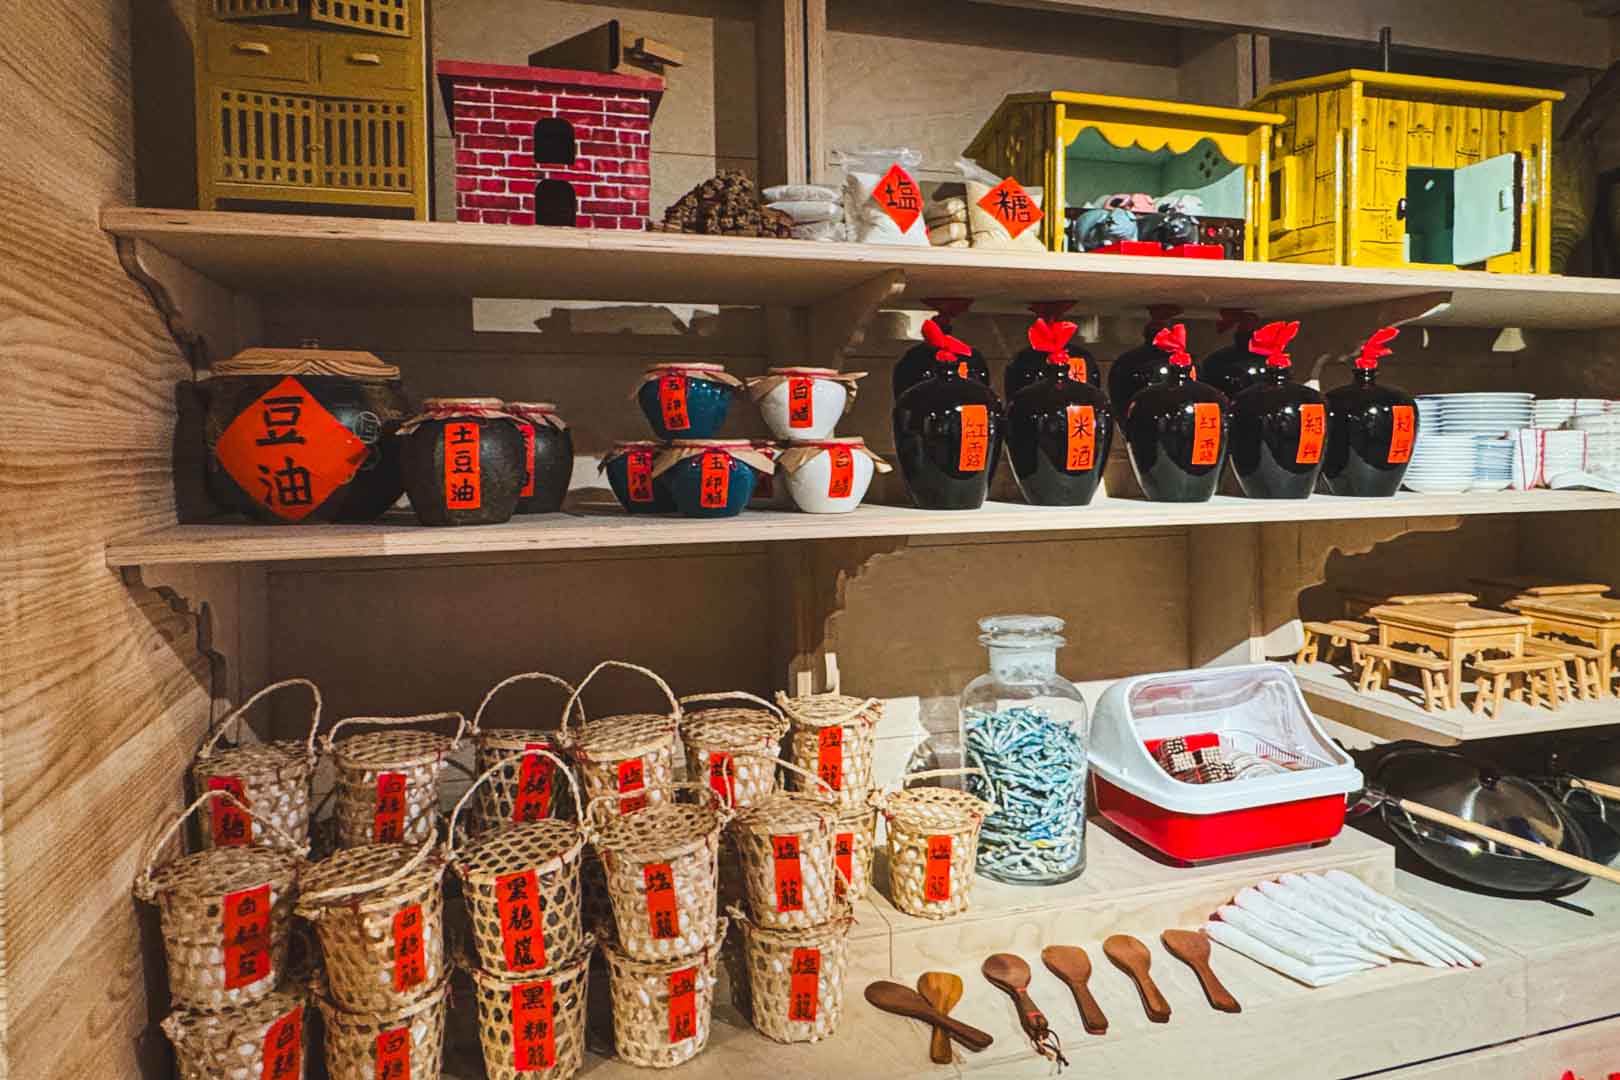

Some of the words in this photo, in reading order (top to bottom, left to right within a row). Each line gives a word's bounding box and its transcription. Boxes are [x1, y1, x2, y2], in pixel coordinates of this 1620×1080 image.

[886, 175, 919, 212] 塩
[992, 189, 1032, 223] 糖
[255, 395, 312, 506] 豆油
[451, 426, 475, 502] 土豆油
[1071, 415, 1093, 467] 米酒
